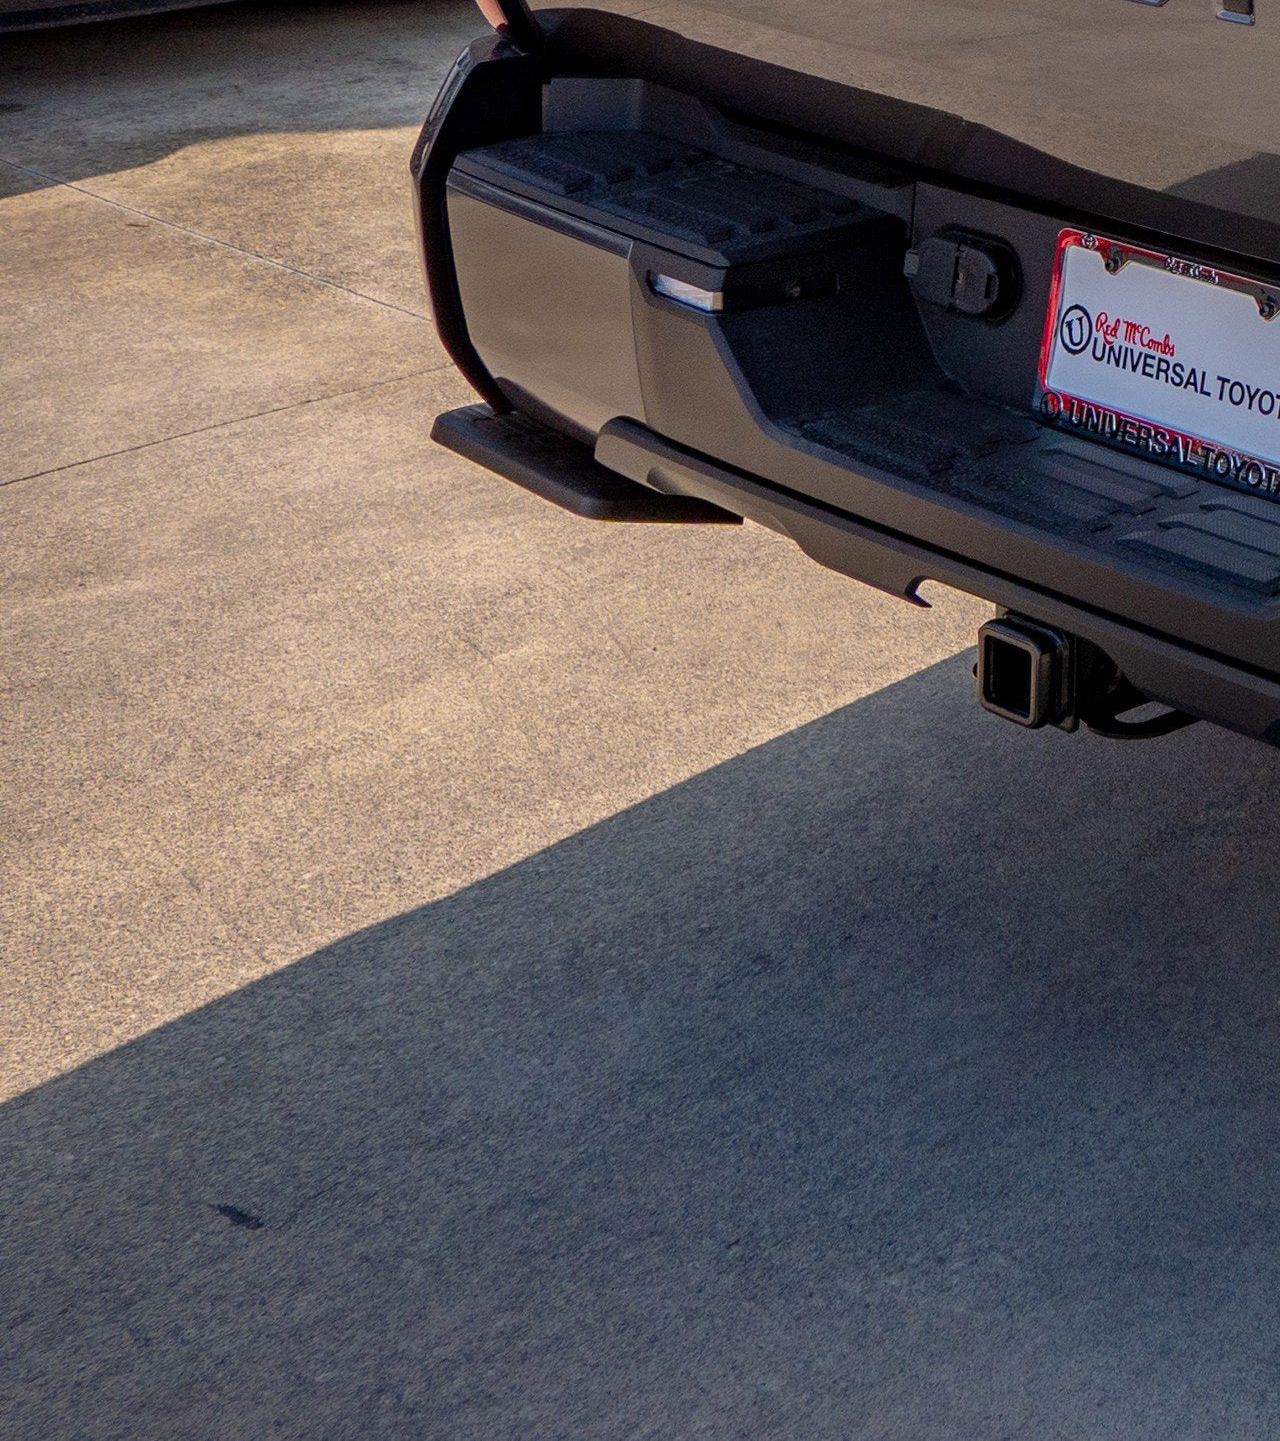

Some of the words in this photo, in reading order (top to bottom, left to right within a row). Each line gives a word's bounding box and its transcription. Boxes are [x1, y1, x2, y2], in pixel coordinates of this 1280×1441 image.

[1095, 311, 1121, 346] Red
[1123, 319, 1176, 357] McCombs
[1092, 337, 1212, 398] UNIVERSAL
[1069, 398, 1198, 466] UNIVERSAL
